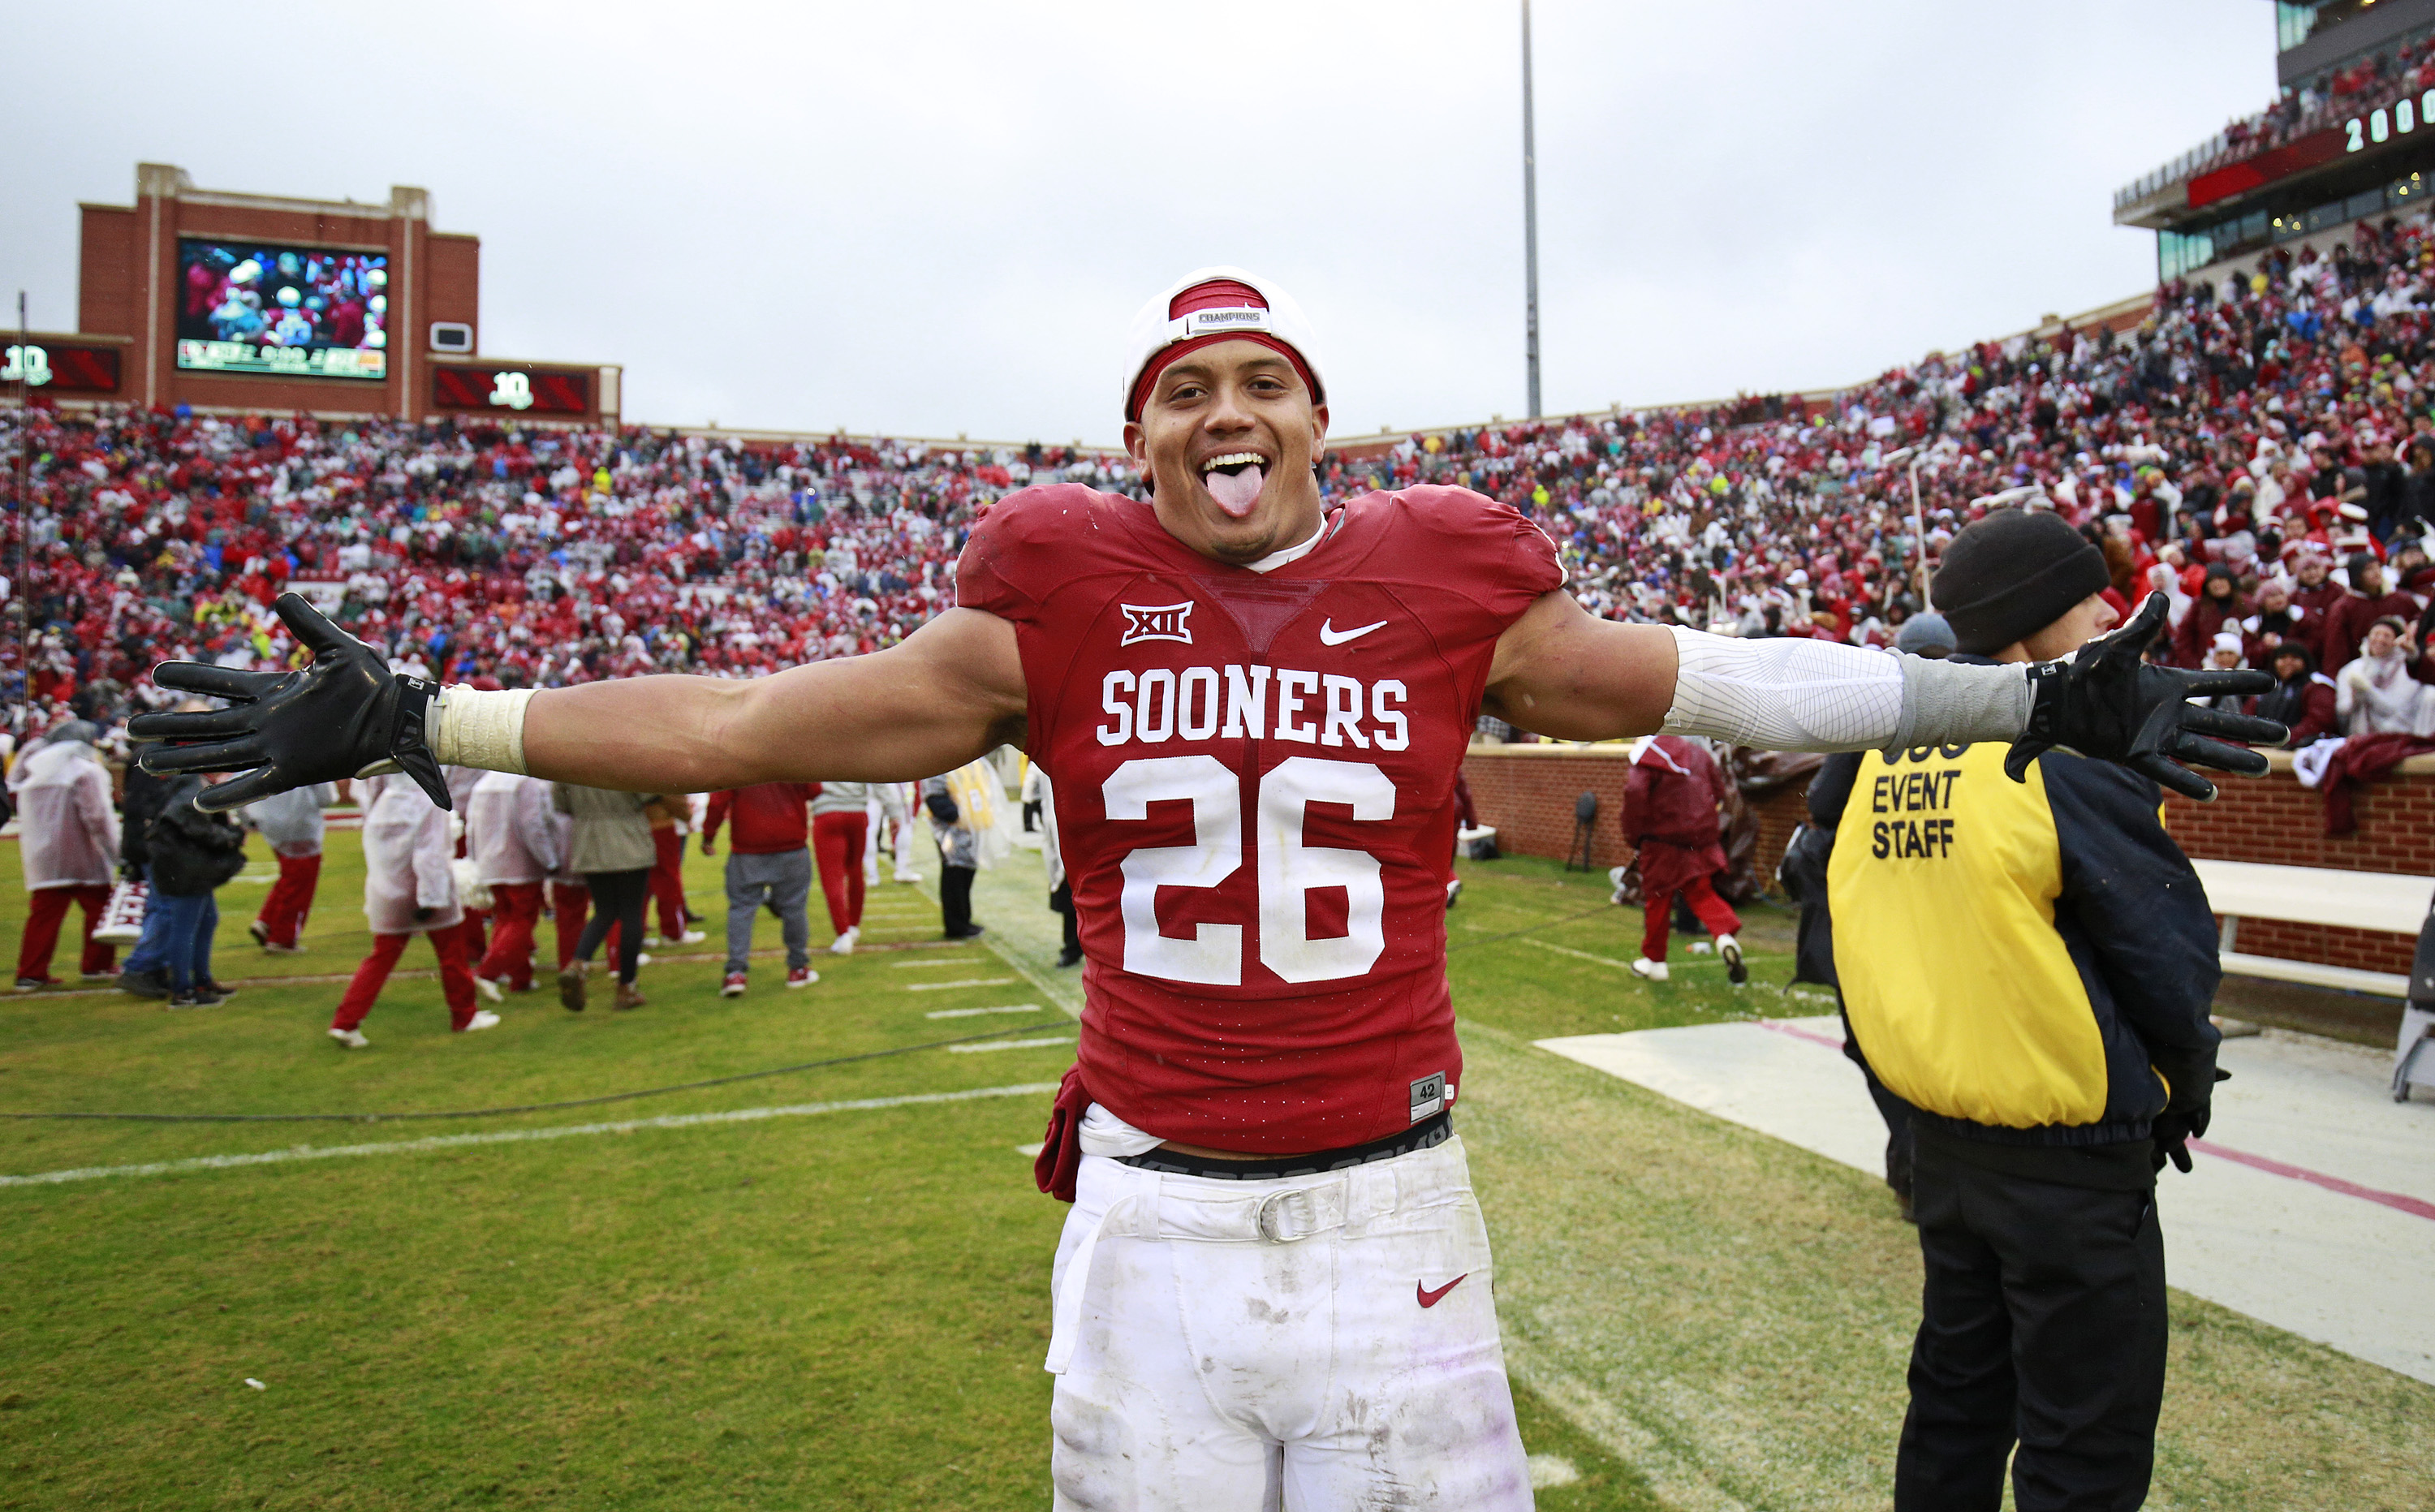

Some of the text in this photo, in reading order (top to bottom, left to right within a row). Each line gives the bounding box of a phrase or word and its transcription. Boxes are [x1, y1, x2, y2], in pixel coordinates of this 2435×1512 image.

[1198, 312, 1261, 323] CHAMPIONS
[1123, 604, 1191, 643] XII
[1097, 664, 1410, 751] SOONERS
[1873, 770, 1961, 812] EVENT
[1873, 819, 1954, 859] STAFF
[1101, 755, 1397, 986] 26
[1420, 1083, 1435, 1098] 42
